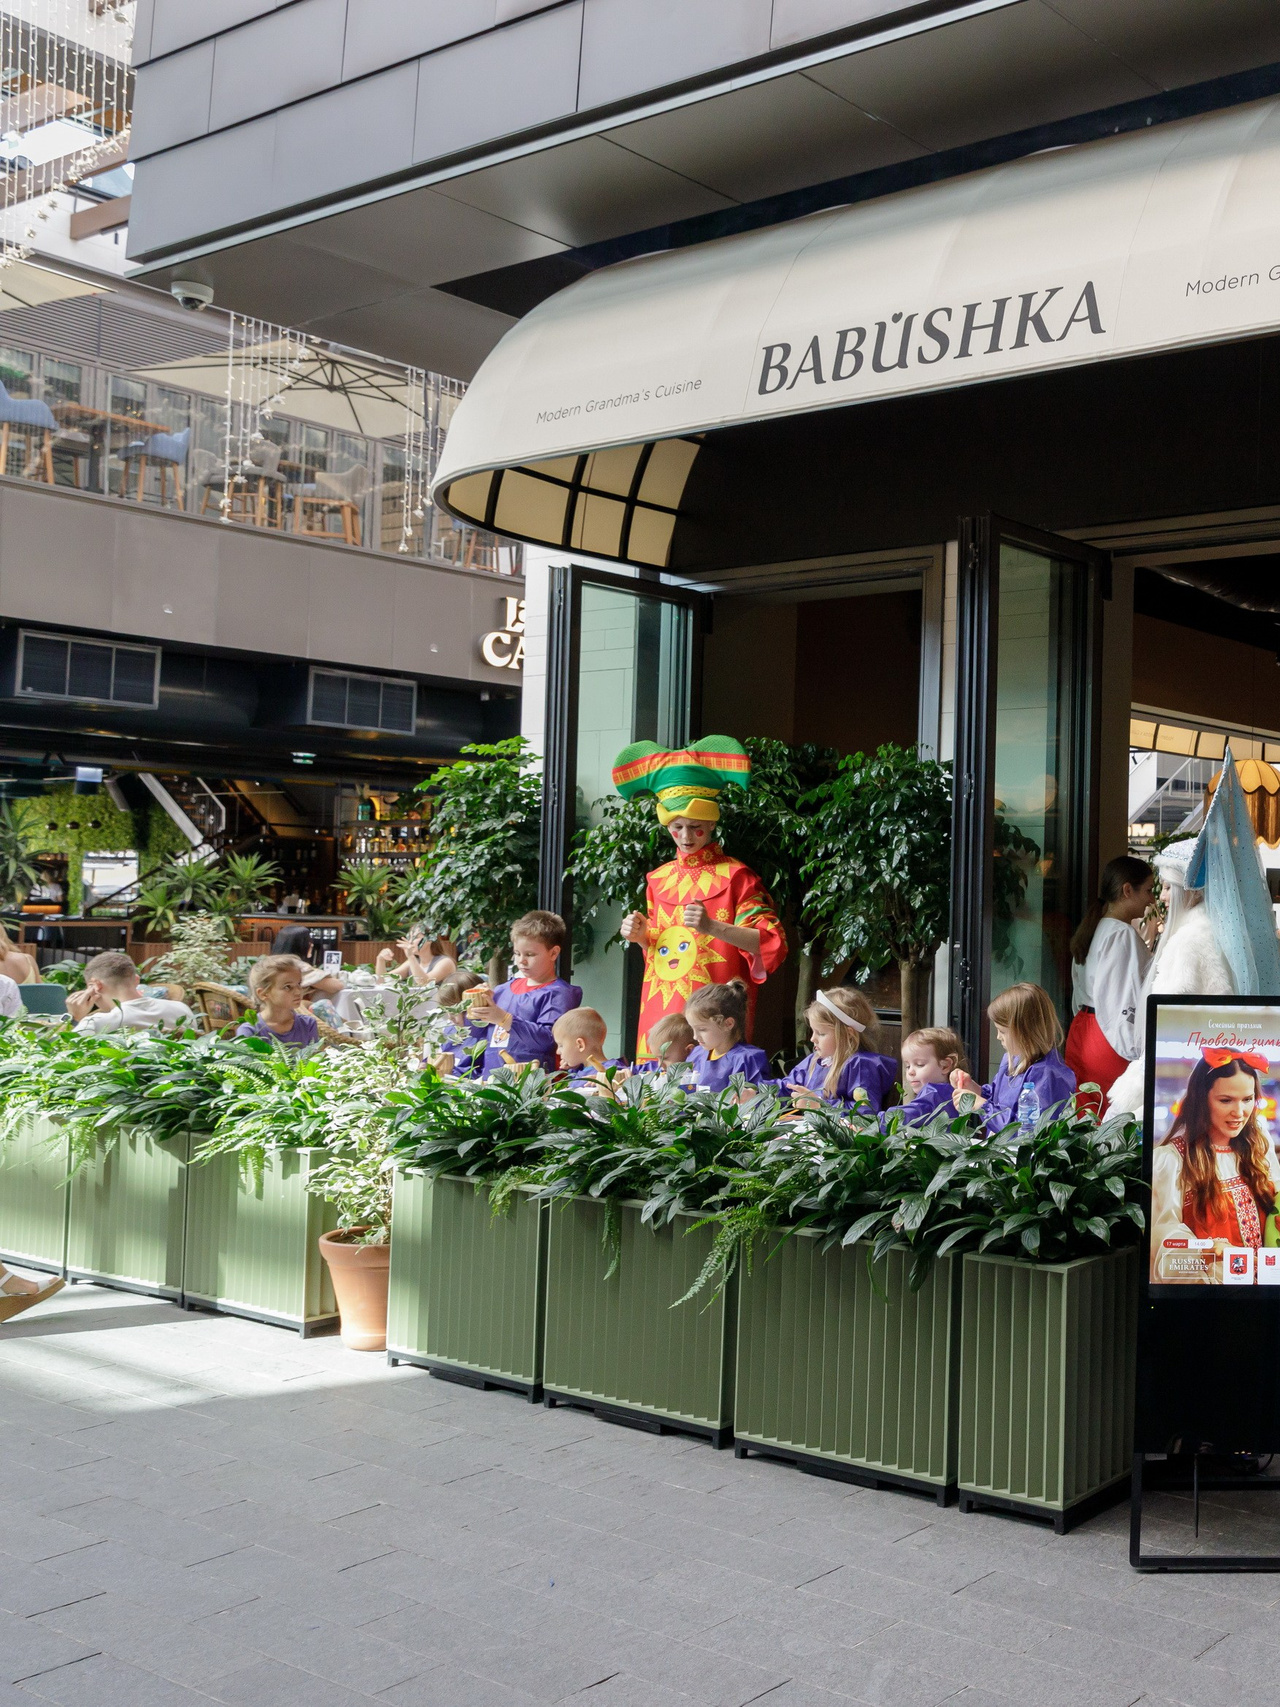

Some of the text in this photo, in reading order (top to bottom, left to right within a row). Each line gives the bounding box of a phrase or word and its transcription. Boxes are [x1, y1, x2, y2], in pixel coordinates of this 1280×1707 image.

[1185, 272, 1260, 297] Modern
[536, 404, 581, 424] Modern
[654, 378, 702, 399] Cuisine
[1187, 1032, 1247, 1050] Проводы
